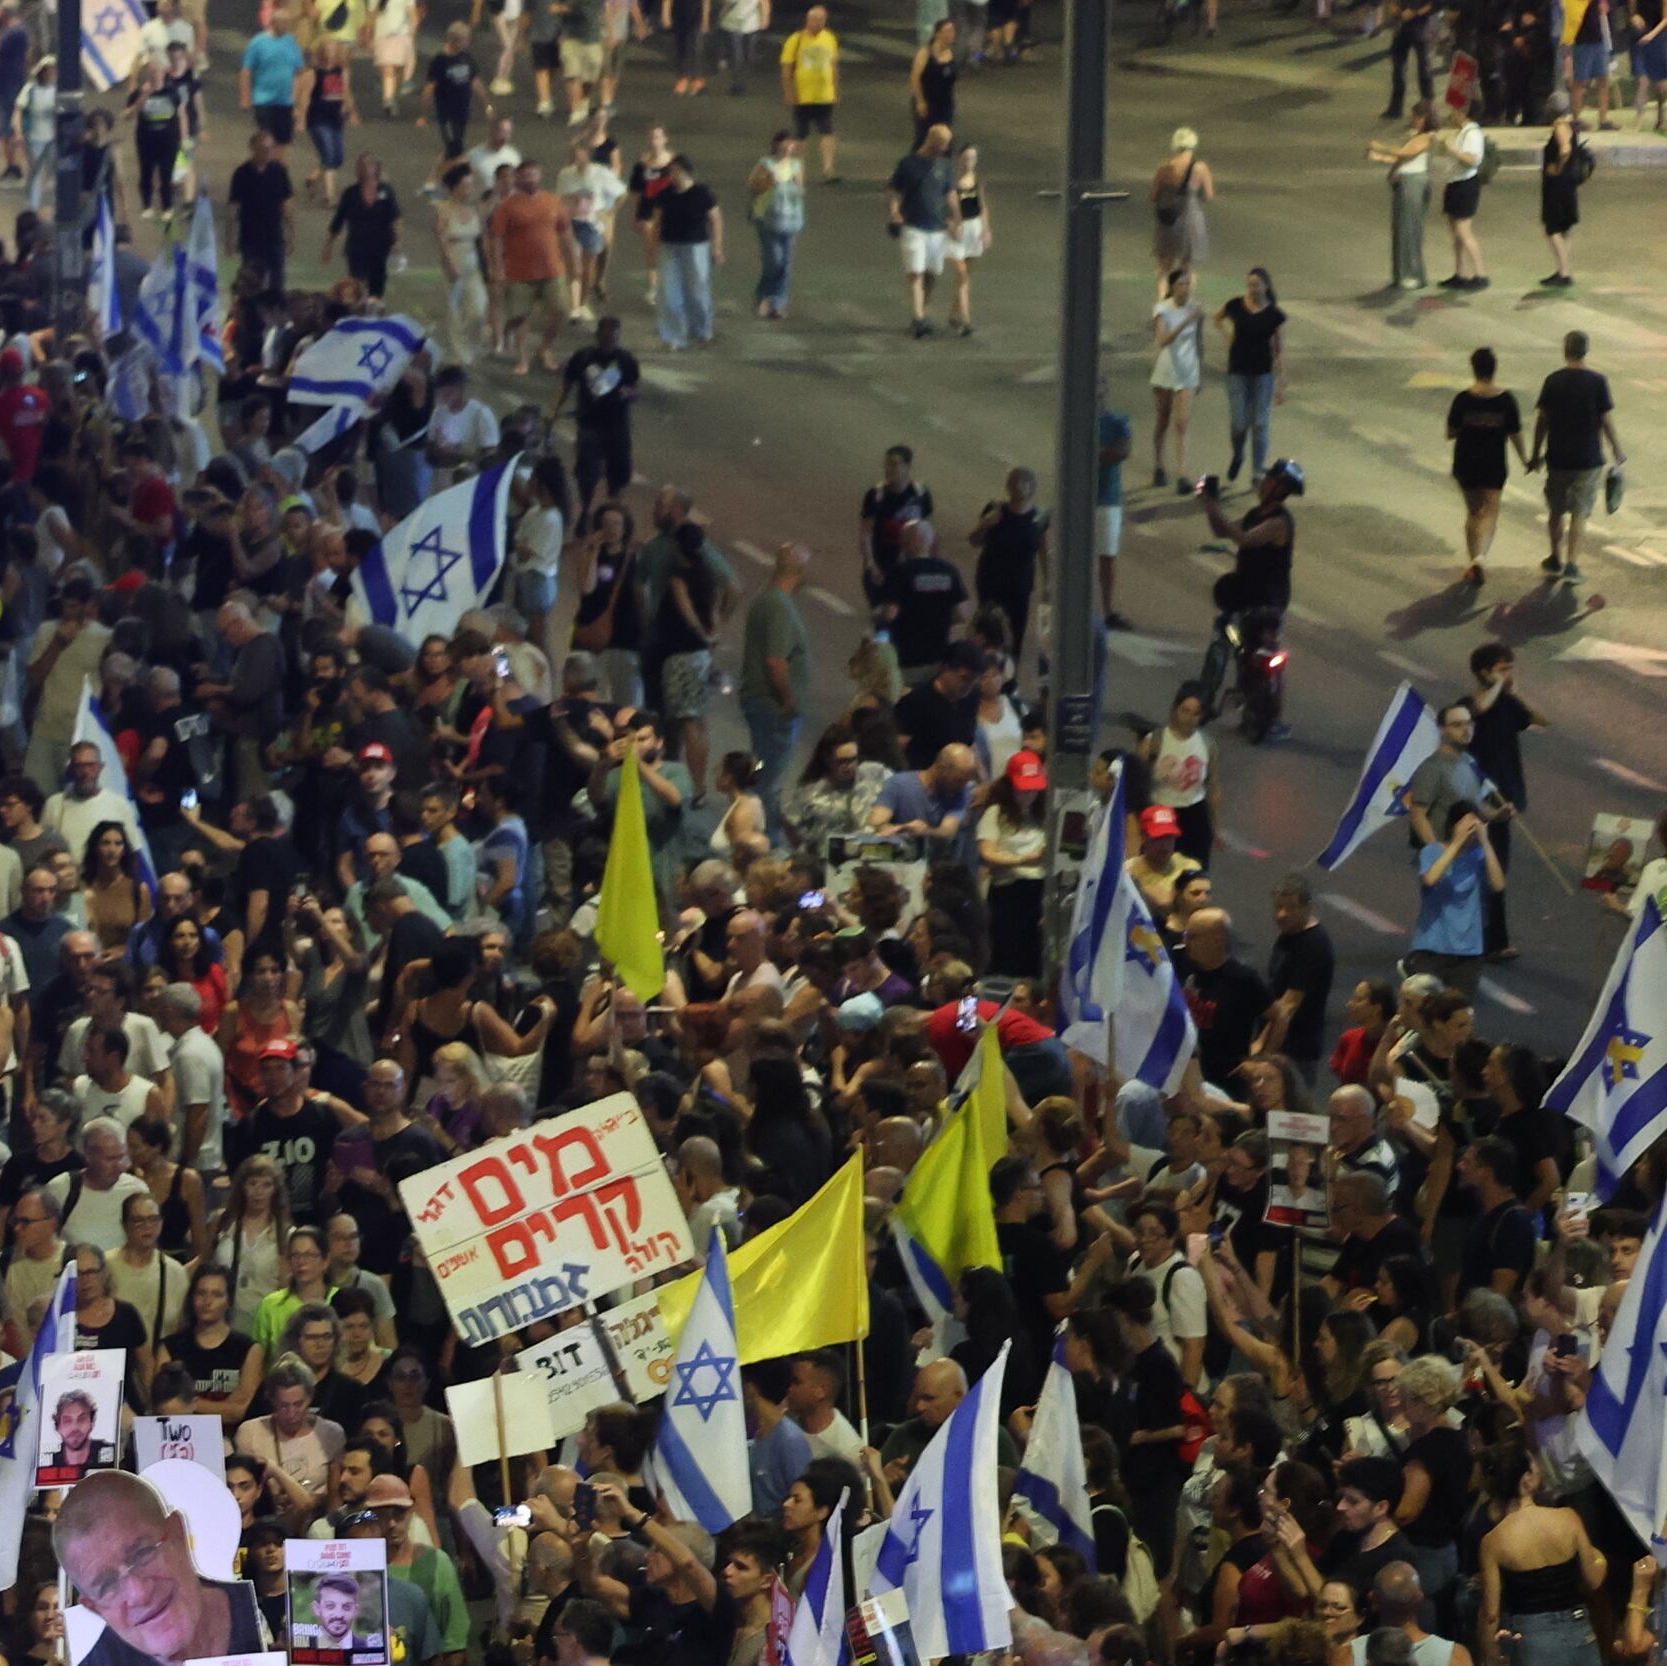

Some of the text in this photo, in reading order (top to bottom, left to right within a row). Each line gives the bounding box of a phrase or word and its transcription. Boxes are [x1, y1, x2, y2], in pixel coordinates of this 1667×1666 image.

[458, 1126, 611, 1226] מים
[485, 1175, 641, 1279] קרים
[293, 1624, 319, 1636] BRING
